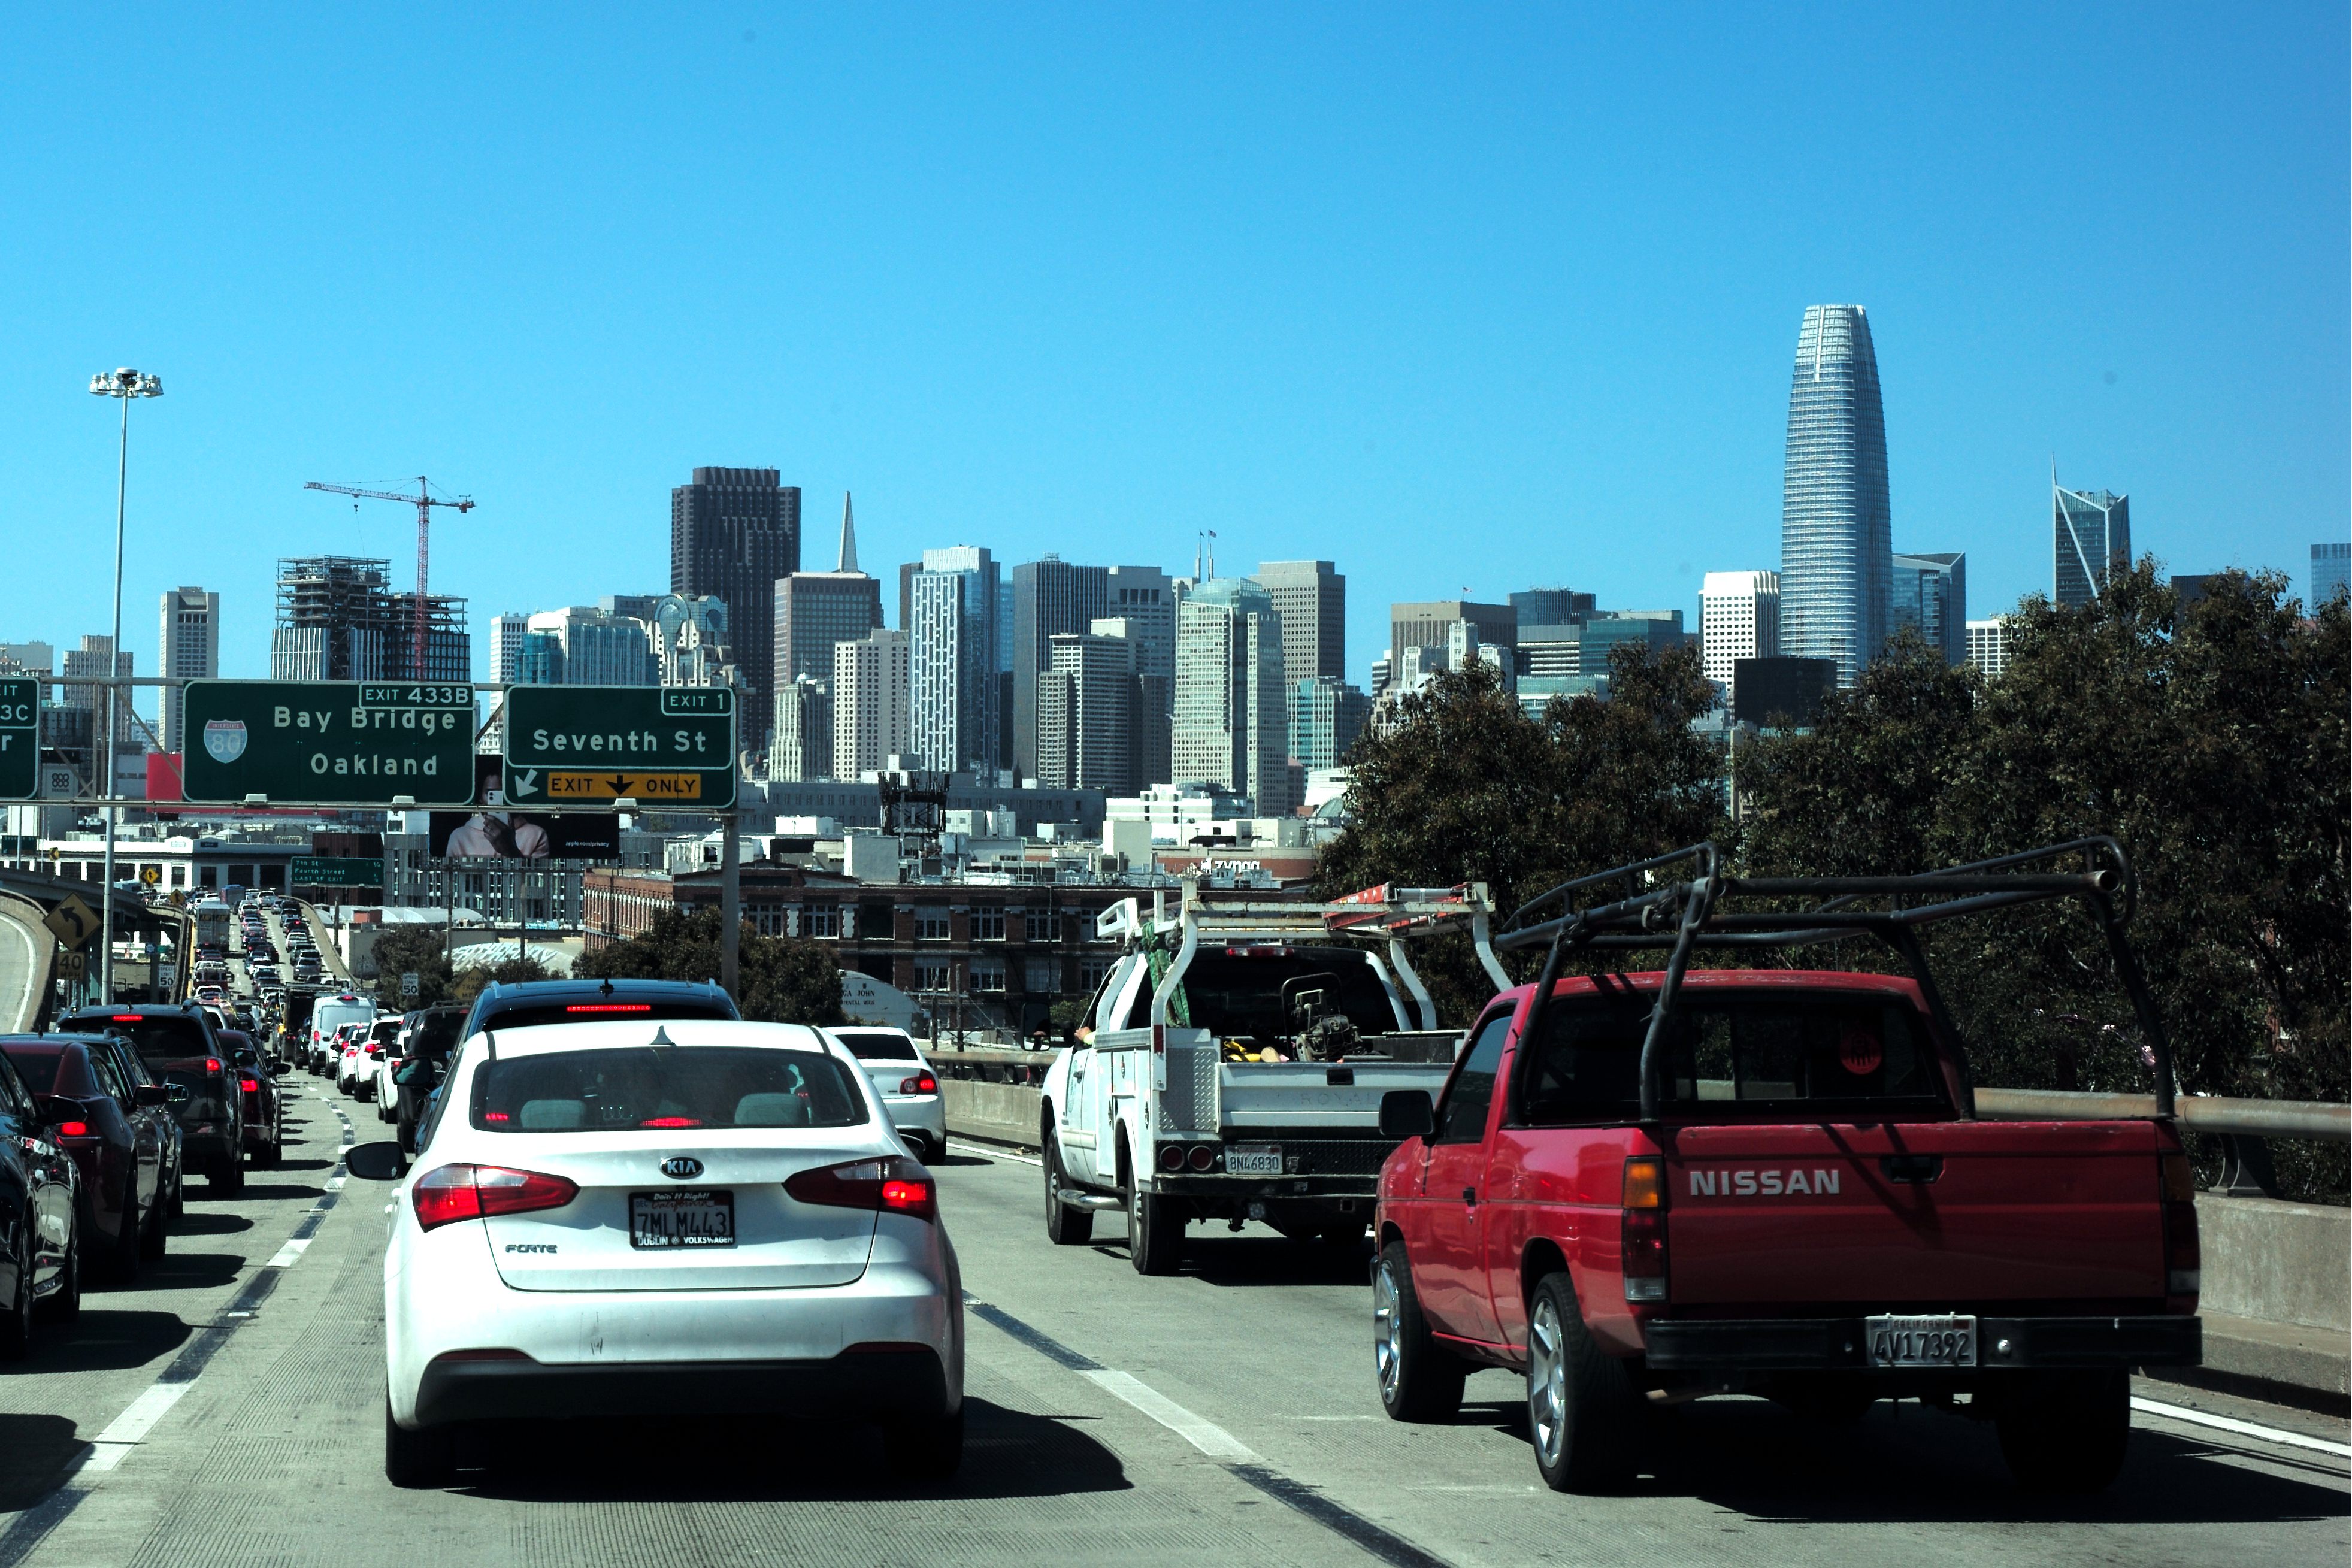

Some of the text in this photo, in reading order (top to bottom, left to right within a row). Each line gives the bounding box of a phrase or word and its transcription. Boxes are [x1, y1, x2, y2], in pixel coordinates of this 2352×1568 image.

[0, 685, 18, 697] IT
[366, 687, 468, 704] EXIT 433B
[670, 694, 723, 709] EXIT 1
[0, 704, 29, 721] 3C
[274, 706, 455, 737] Bay Bridge
[211, 734, 241, 753] 80
[533, 729, 706, 752] Seventh St
[310, 752, 437, 776] Oakland
[552, 778, 696, 793] EXIT ONLY
[59, 954, 82, 970] 40
[160, 977, 174, 986] 50
[404, 985, 417, 994] 50
[667, 1160, 696, 1173] KIA
[1230, 1156, 1279, 1170] 8N46830
[1690, 1170, 1840, 1195] NISSAN
[684, 1192, 710, 1201] Right!
[637, 1212, 727, 1236] 7MLM443
[638, 1236, 668, 1246] DUBLIN
[505, 1244, 558, 1254] FORTE
[1893, 1319, 1950, 1328] CALIFORNIA
[1873, 1331, 1970, 1359] 4V17392
